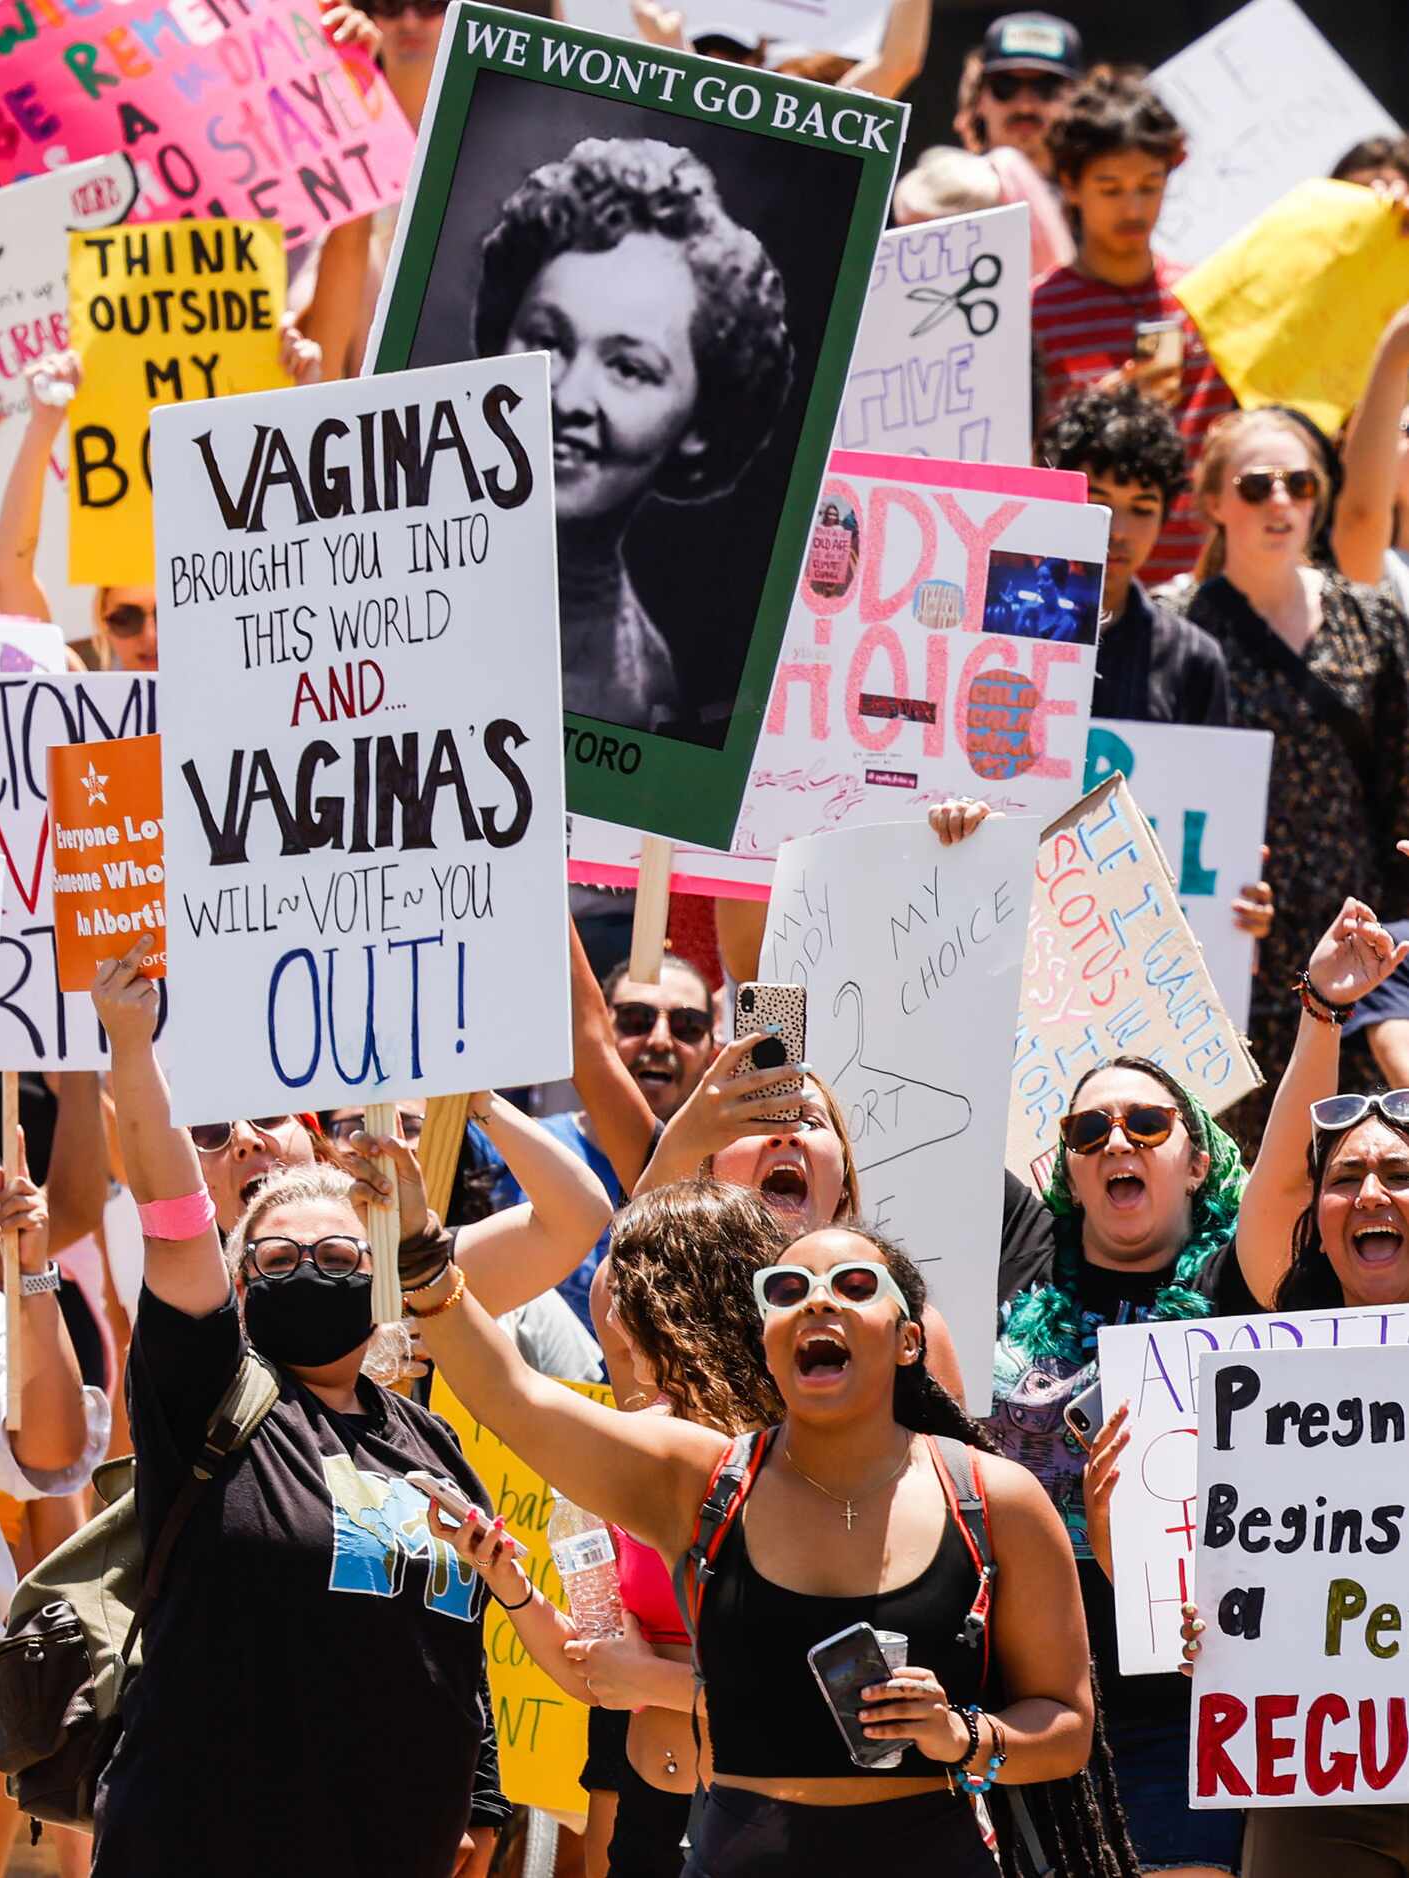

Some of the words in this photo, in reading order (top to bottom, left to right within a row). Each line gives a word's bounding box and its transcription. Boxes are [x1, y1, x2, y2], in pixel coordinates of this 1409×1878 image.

[466, 18, 531, 67] WE
[541, 36, 688, 104] WON'T
[692, 75, 762, 121] GO
[770, 91, 895, 154] BACK
[84, 225, 260, 279] THINK
[90, 288, 274, 338] OUTSIDE
[145, 353, 221, 400] MY
[191, 383, 534, 535] VAGINA'S
[169, 538, 311, 609] BROUGHT
[322, 530, 384, 588] YOU
[405, 511, 491, 575] INTO
[234, 604, 318, 670] THIS
[328, 588, 452, 653] WORLD
[56, 822, 120, 853] Everyone
[180, 718, 534, 867] VAGINA'S
[75, 910, 92, 937] An
[772, 869, 813, 980] MY
[890, 865, 942, 961] MY
[901, 880, 1015, 1017] CHOICE
[1035, 834, 1130, 1007] SCOTUS
[267, 929, 467, 1090] OUT!
[1142, 927, 1232, 1087] WANTED
[1213, 1364, 1406, 1451] Pregn
[1203, 1483, 1406, 1555] Begins
[1217, 1585, 1267, 1641] a
[1196, 1692, 1409, 1798] REGU
